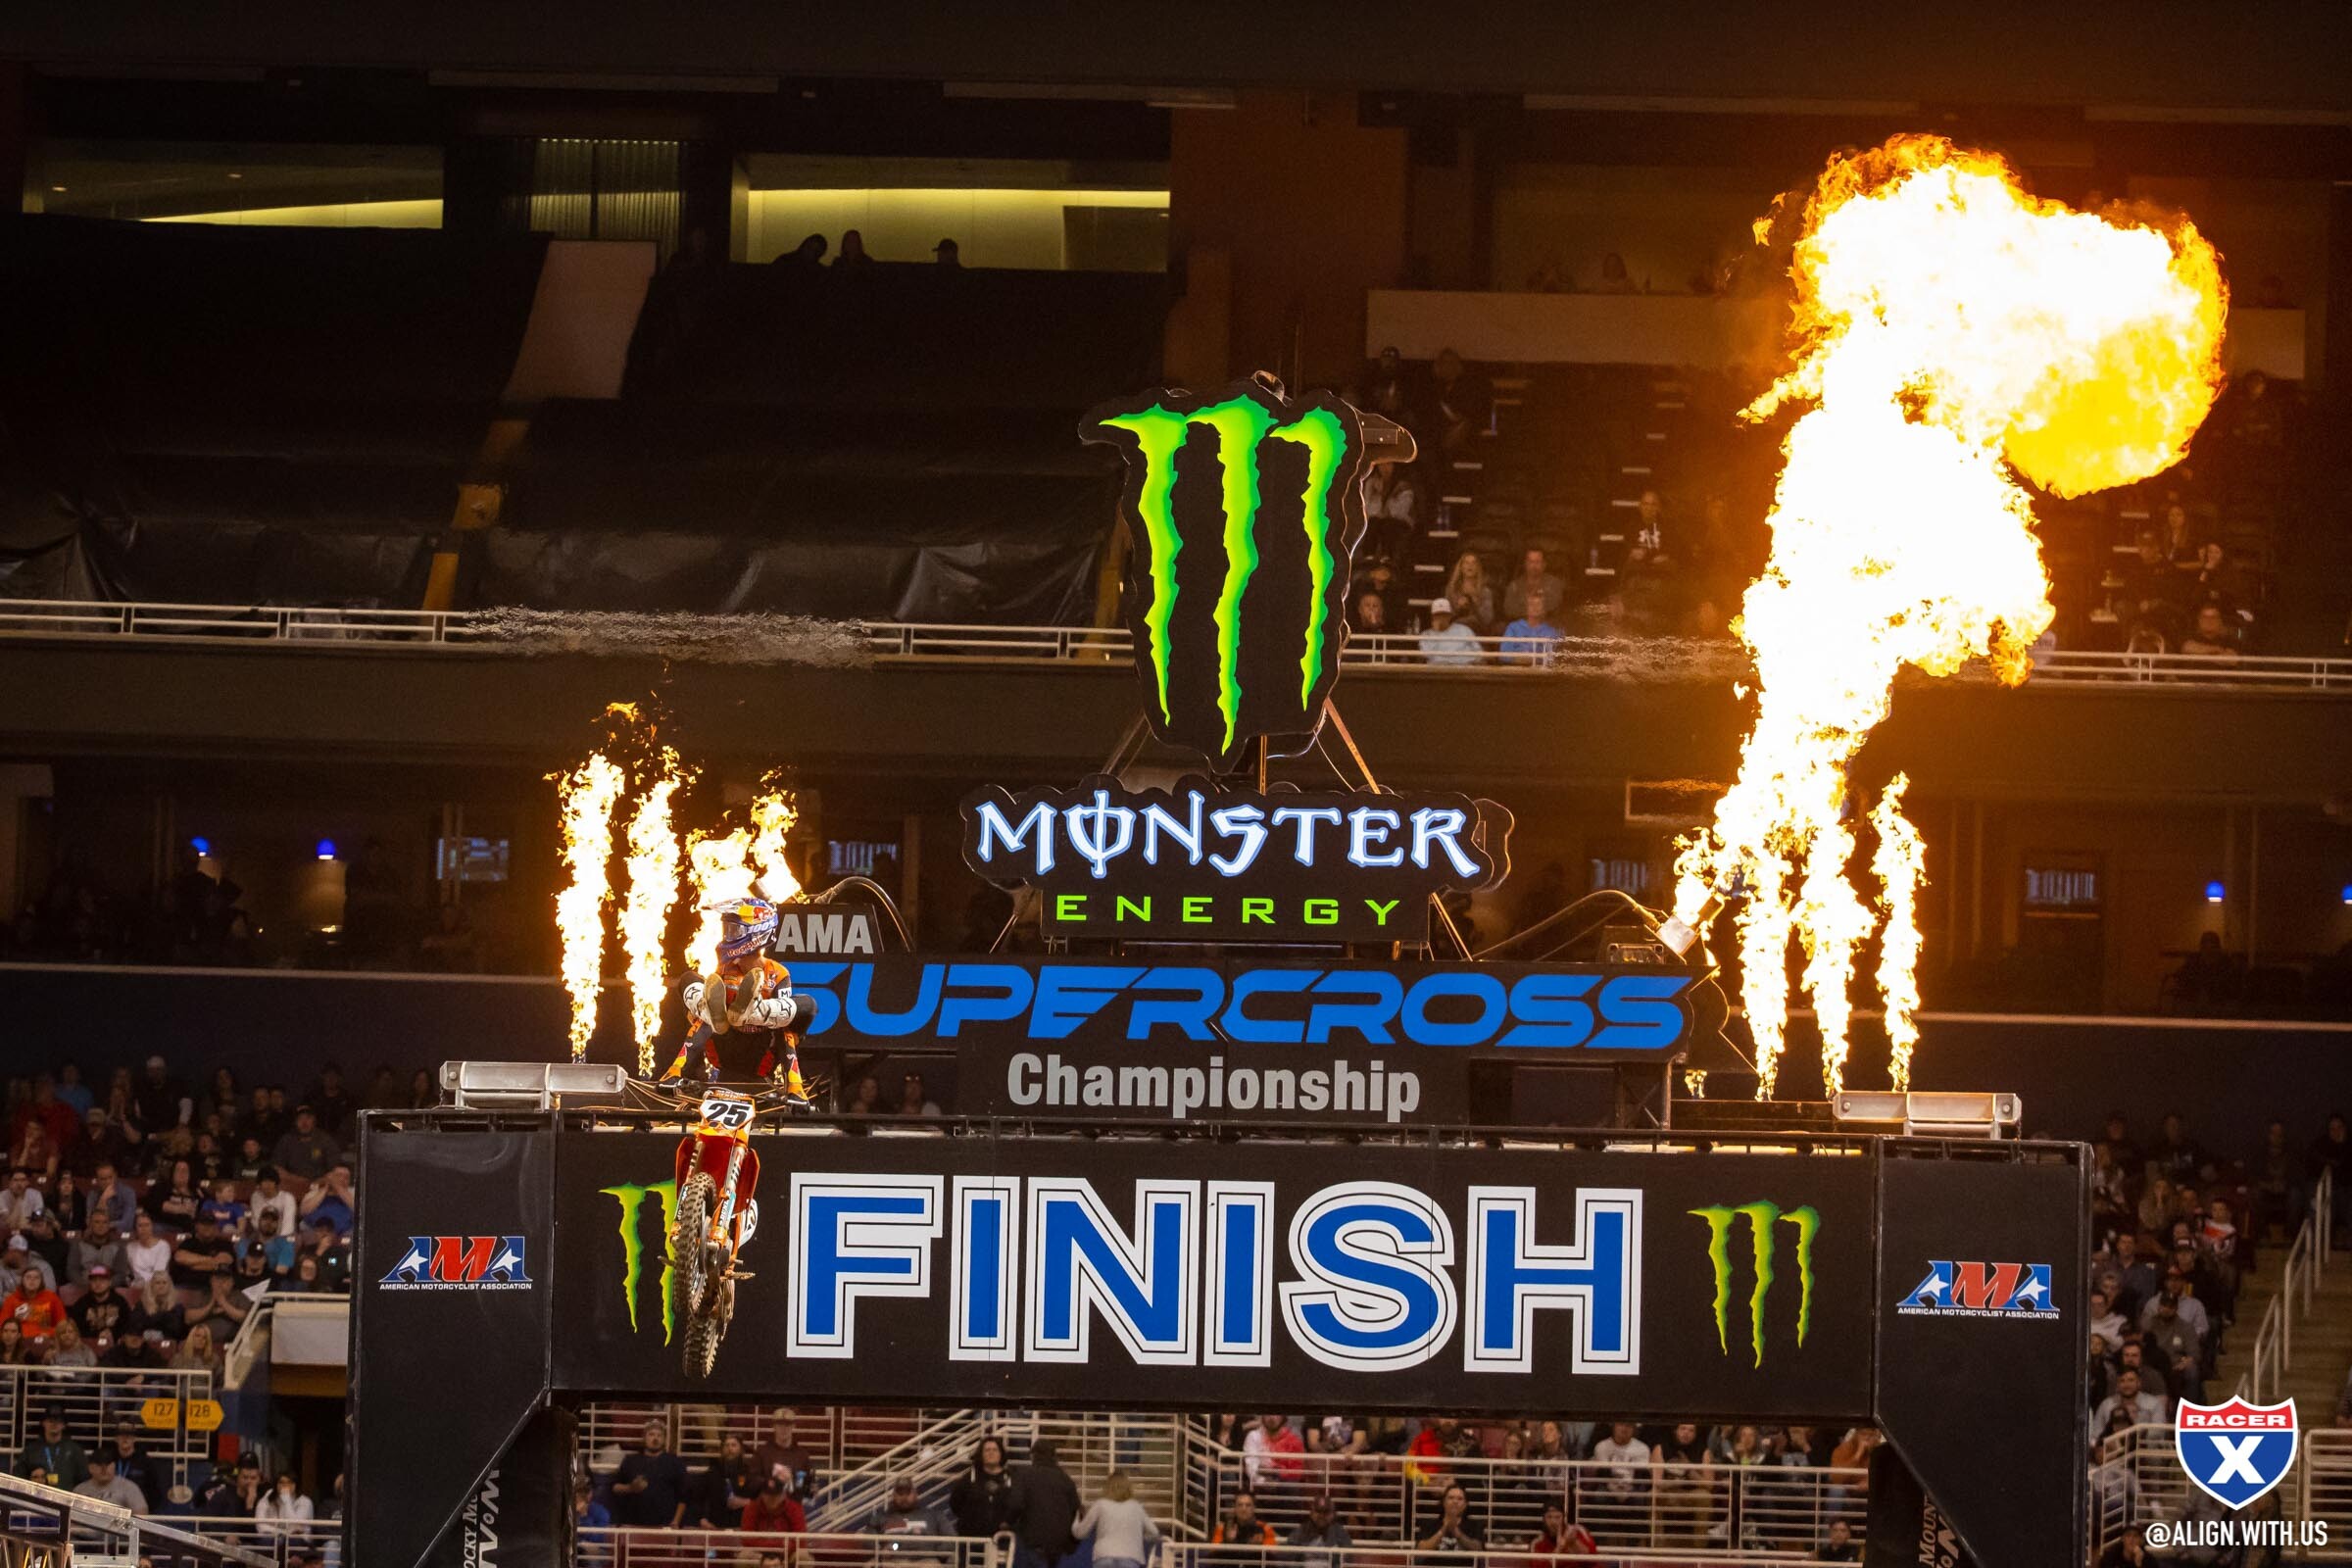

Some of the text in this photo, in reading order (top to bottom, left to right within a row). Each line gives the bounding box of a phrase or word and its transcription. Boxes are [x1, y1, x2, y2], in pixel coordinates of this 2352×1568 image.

[1056, 895, 1400, 926] ENERGY
[775, 914, 874, 954] AMA
[783, 962, 1690, 1049] SUPERCROSS
[1007, 1053, 1420, 1123] Championship
[706, 1102, 751, 1127] 25
[378, 1236, 533, 1283] AMA
[787, 1172, 1643, 1376] FINISH
[1896, 1260, 2061, 1311] AMA
[1897, 1307, 2059, 1320] AMERICAN MOTORCYCLIST ASSOCIATION
[154, 1402, 174, 1416] 127
[189, 1403, 211, 1418] 128
